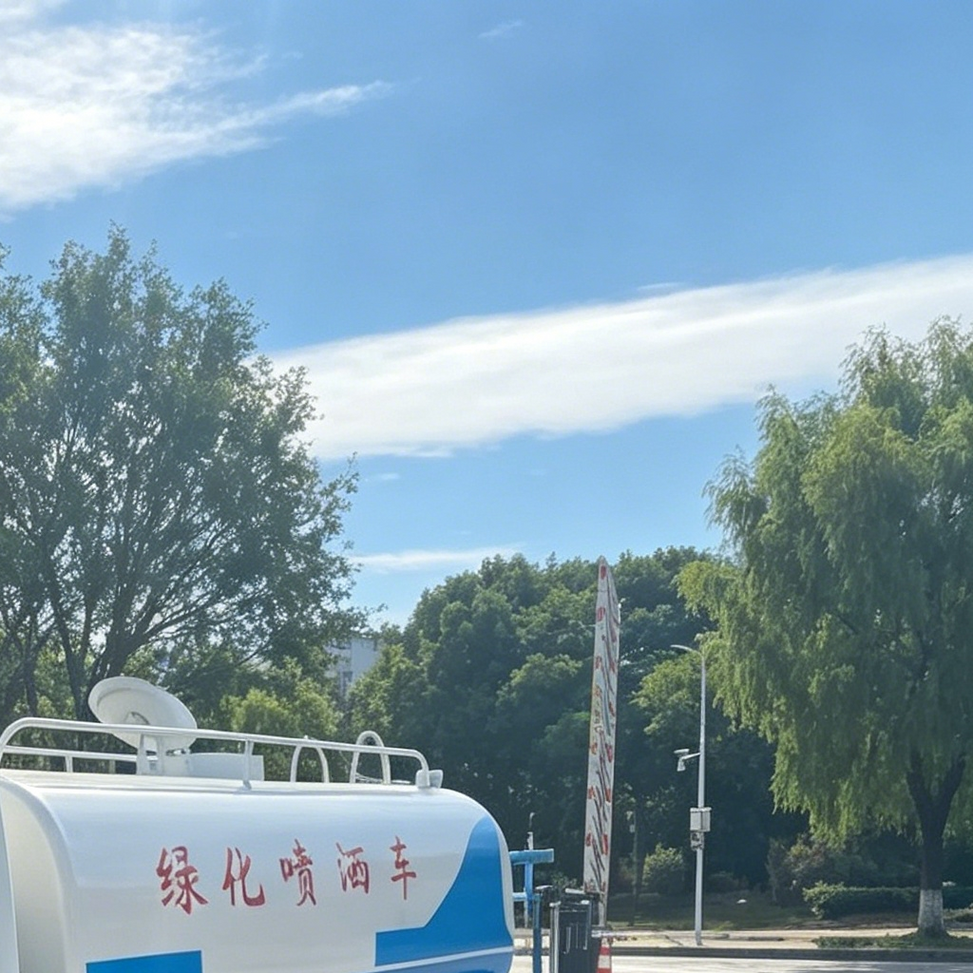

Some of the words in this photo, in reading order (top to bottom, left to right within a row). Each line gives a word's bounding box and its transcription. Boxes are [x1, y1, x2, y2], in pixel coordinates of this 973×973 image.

[156, 836, 417, 915] 绿化喷洒车
